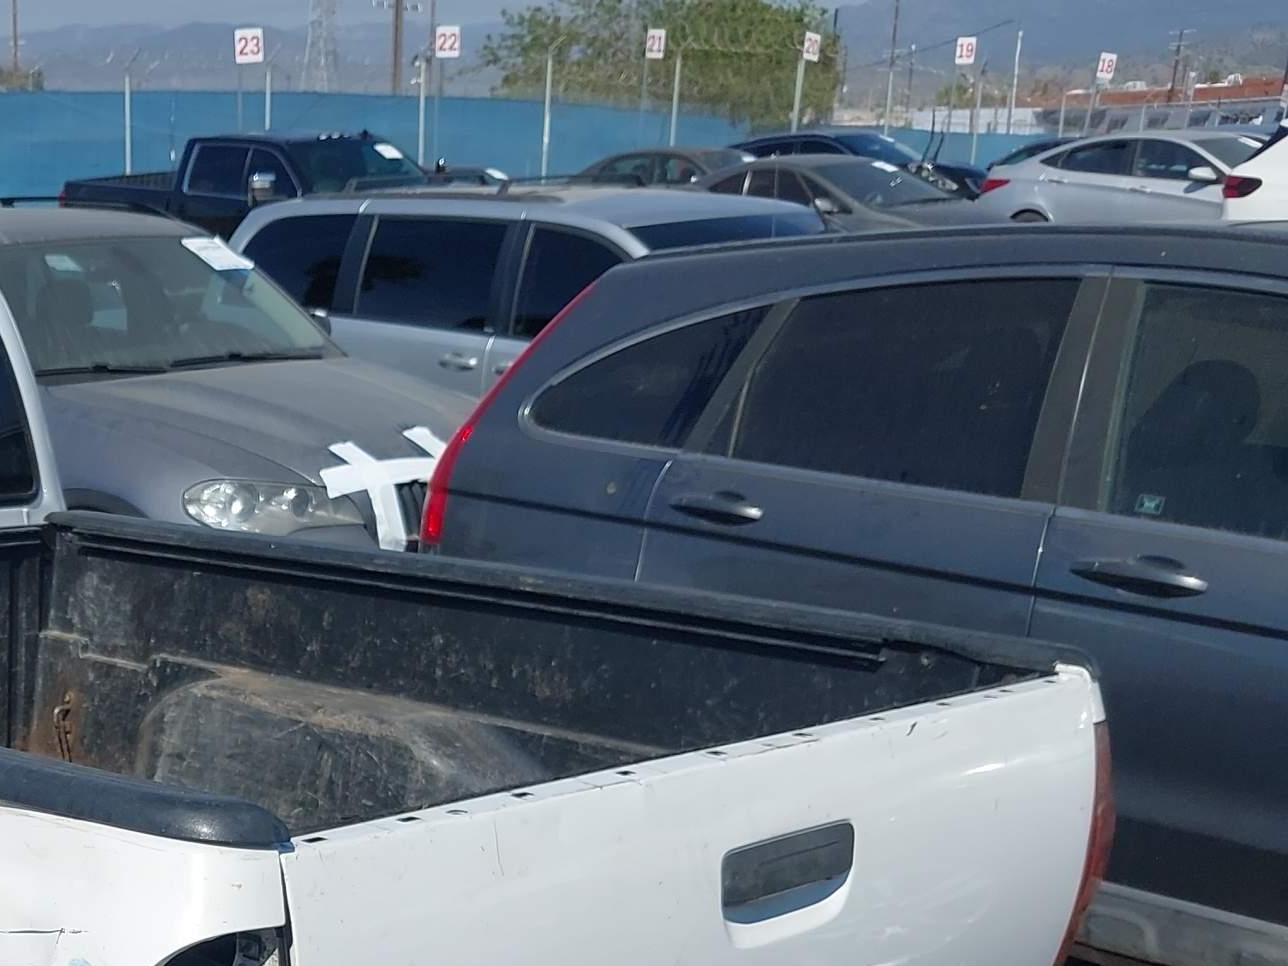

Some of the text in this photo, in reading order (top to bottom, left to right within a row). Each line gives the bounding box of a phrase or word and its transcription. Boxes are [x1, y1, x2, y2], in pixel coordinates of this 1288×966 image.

[238, 36, 260, 56] 23
[438, 33, 457, 52] 22
[648, 35, 662, 52] 21
[806, 38, 819, 55] 20
[957, 43, 974, 59] 19
[1100, 58, 1114, 74] 18
